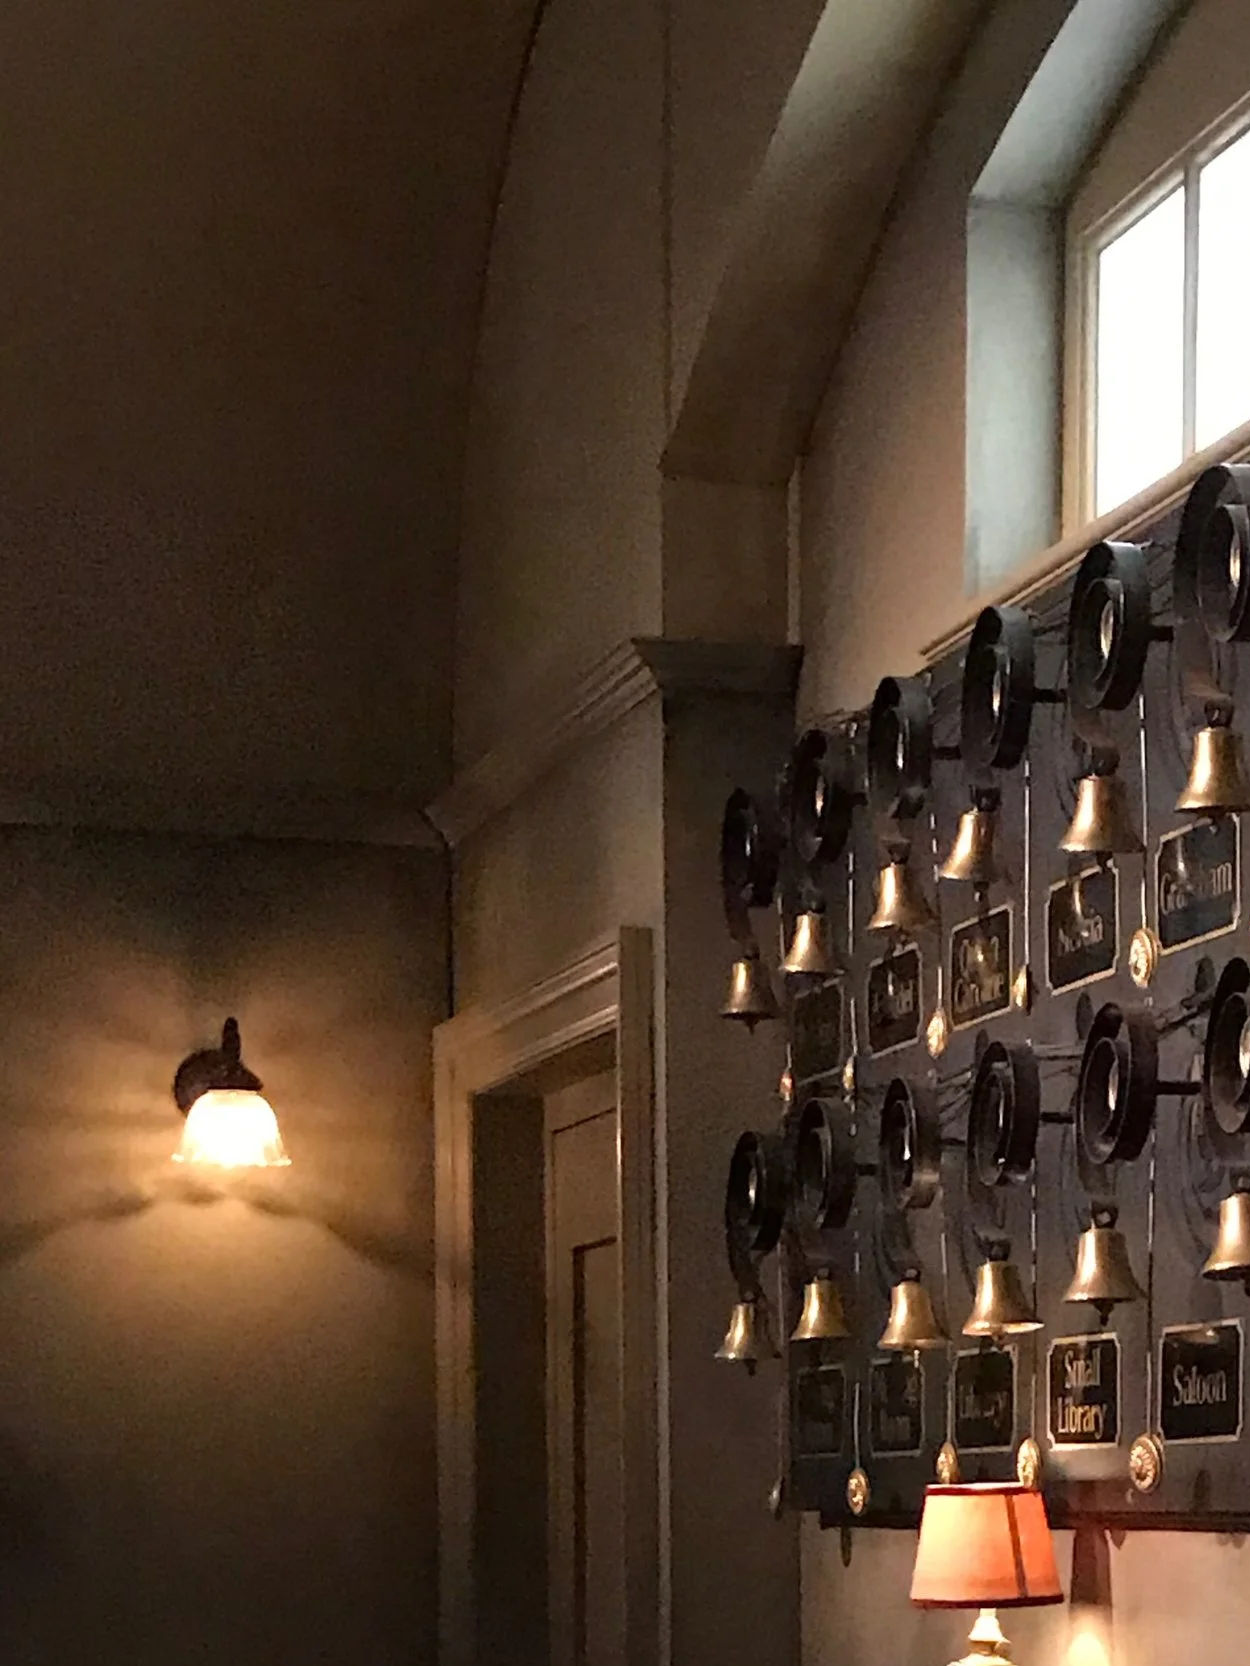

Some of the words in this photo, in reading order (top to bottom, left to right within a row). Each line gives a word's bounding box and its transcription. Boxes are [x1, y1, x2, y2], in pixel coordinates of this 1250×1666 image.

[1063, 1347, 1101, 1389] Small
[1172, 1363, 1228, 1407] Saloon
[1057, 1396, 1107, 1440] Library
